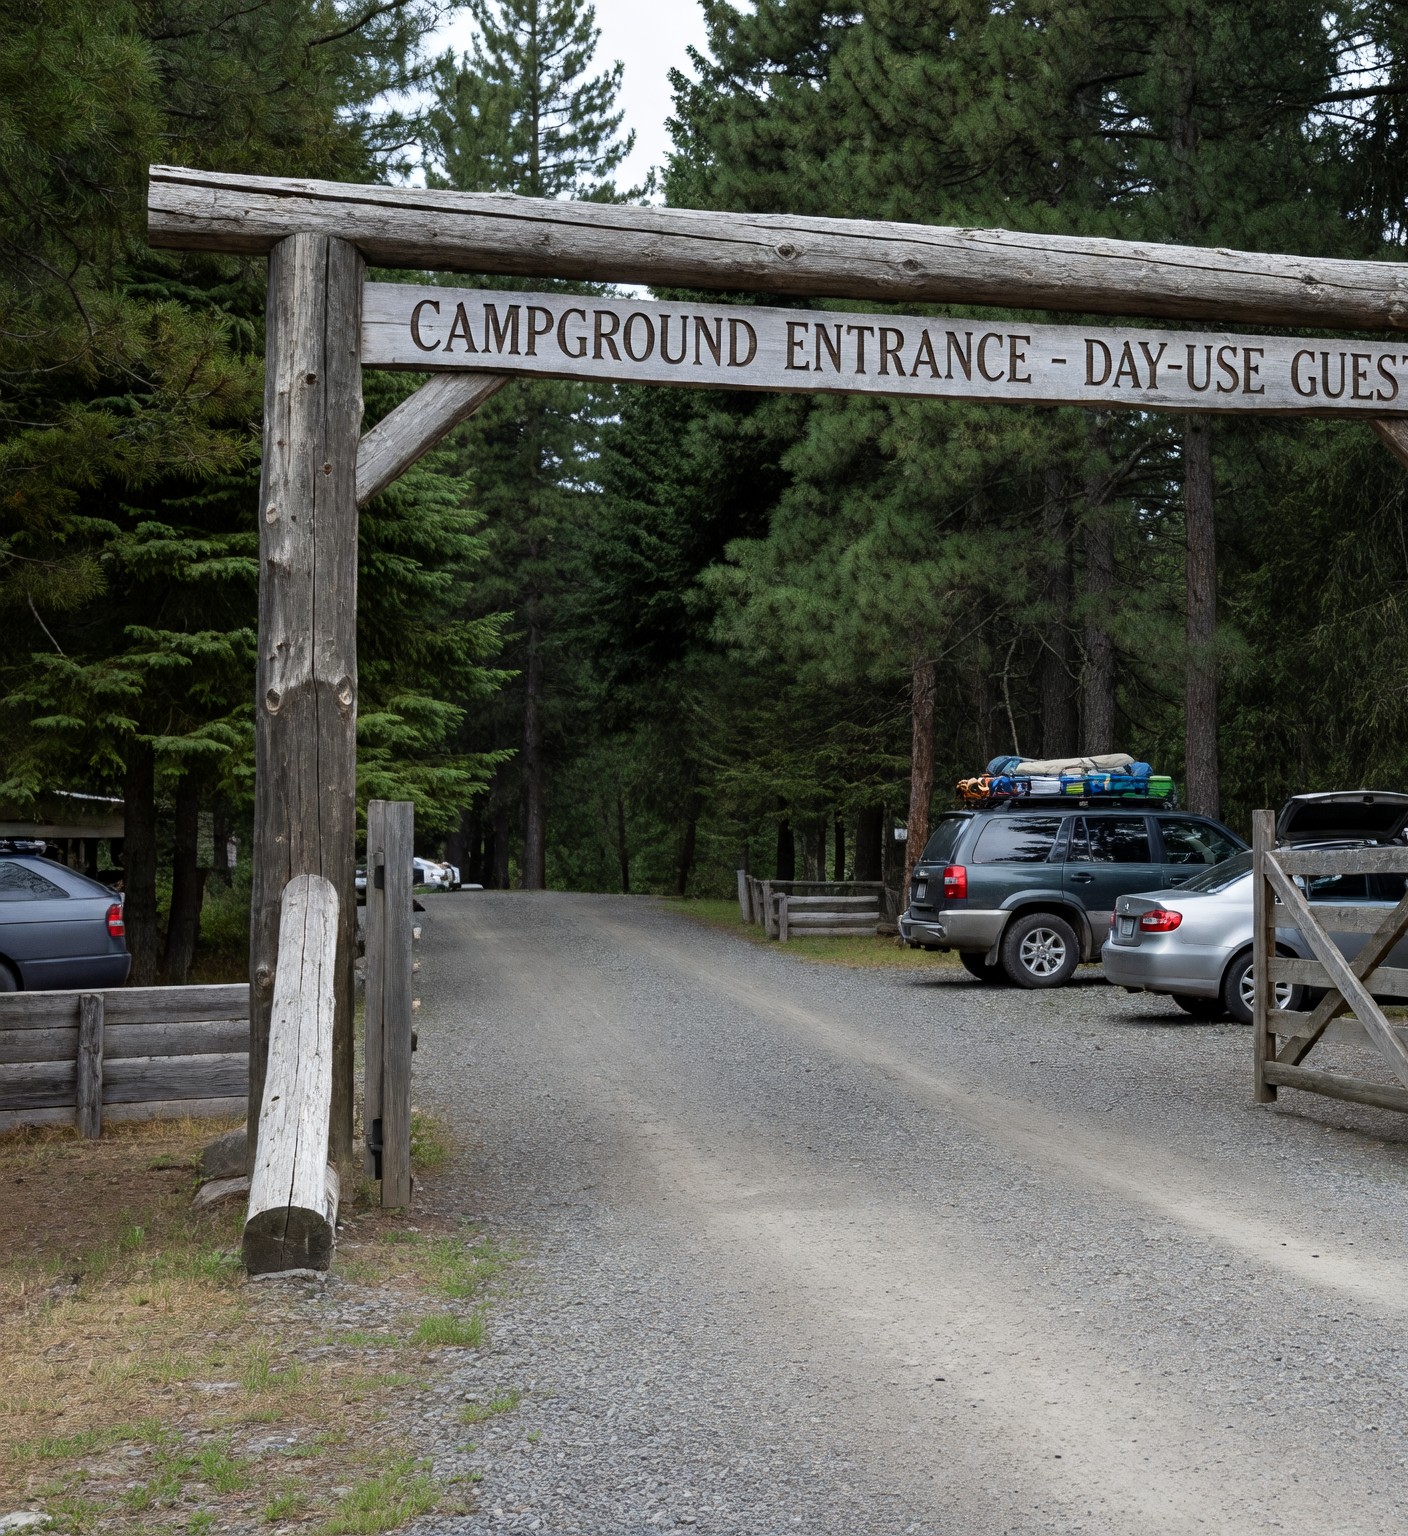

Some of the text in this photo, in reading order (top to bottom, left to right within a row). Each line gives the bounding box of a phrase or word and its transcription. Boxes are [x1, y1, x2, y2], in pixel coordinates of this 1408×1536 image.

[410, 299, 758, 368] CAMPGROUND
[784, 321, 1032, 384] ENTRANCE
[1083, 338, 1265, 395] DAY-USE
